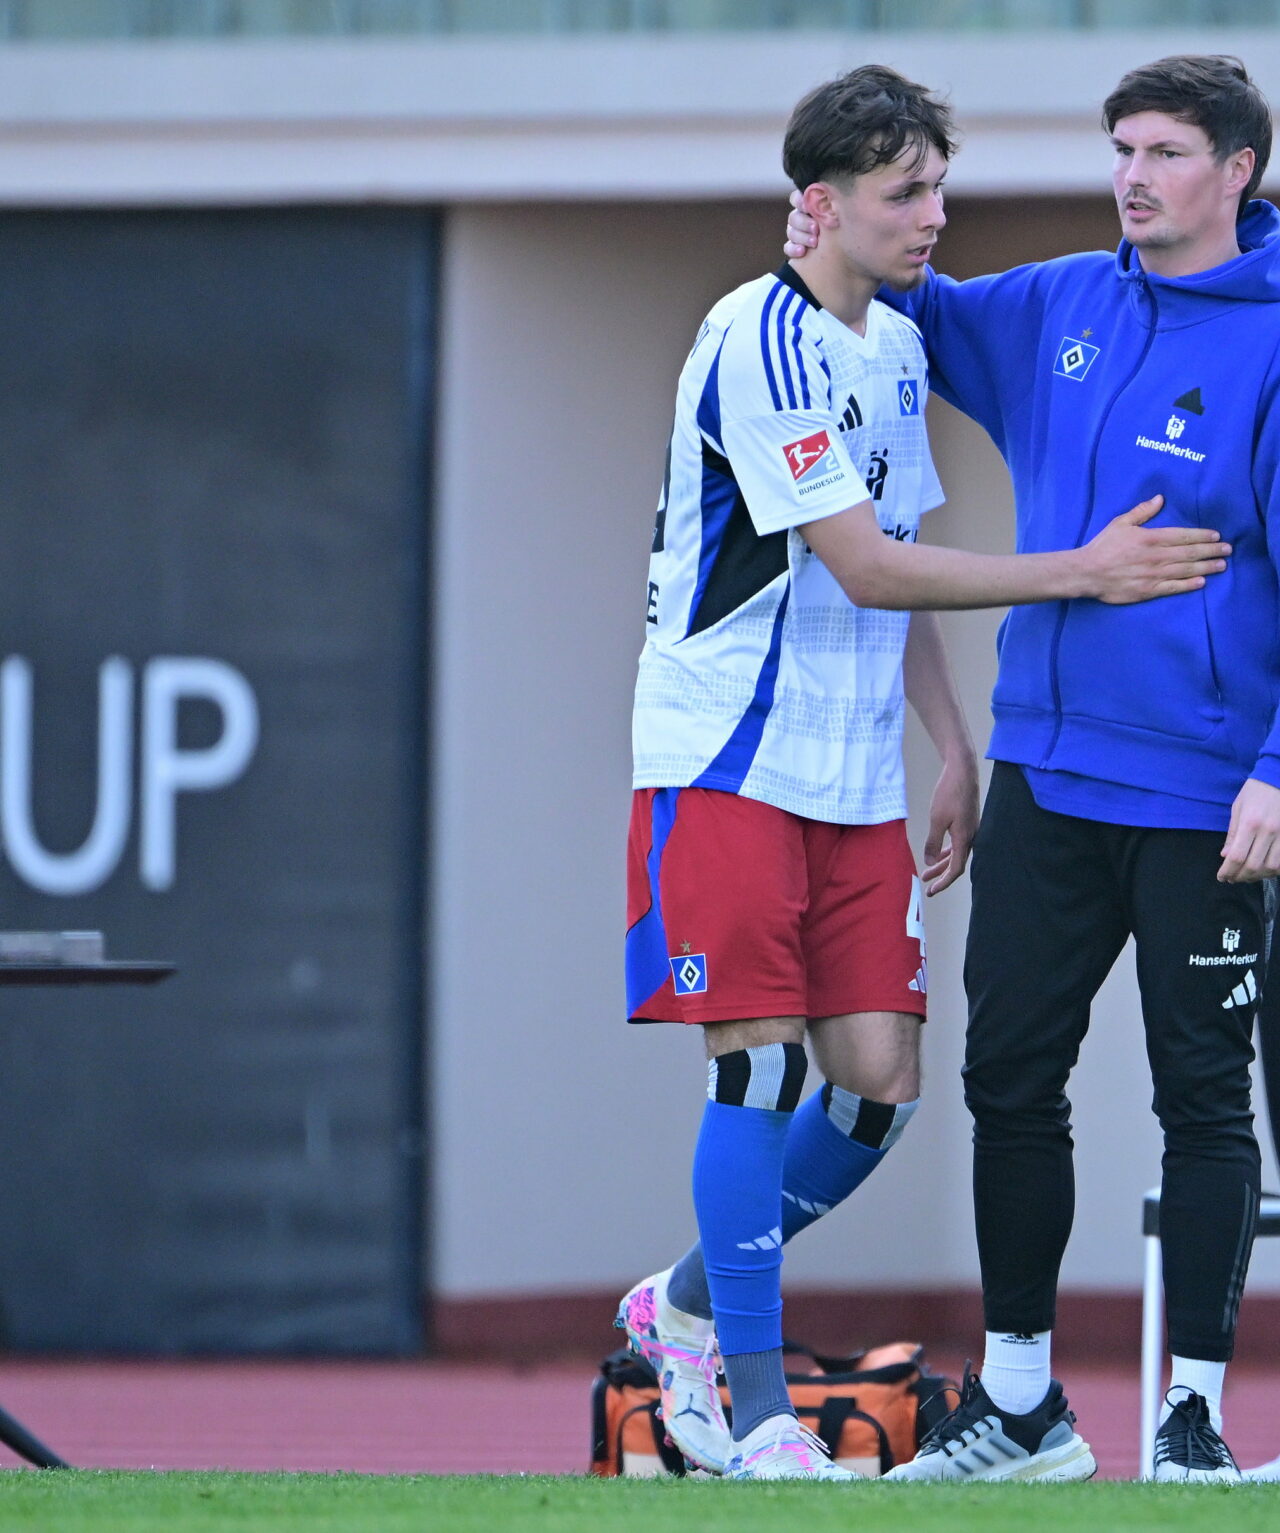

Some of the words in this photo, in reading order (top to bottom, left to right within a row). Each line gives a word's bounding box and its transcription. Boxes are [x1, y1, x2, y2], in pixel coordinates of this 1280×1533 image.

[1136, 435, 1206, 463] HanseMerkur
[798, 472, 846, 496] BUNDESLIGA
[0, 653, 261, 896] UP
[1189, 953, 1258, 966] HanseMerkur
